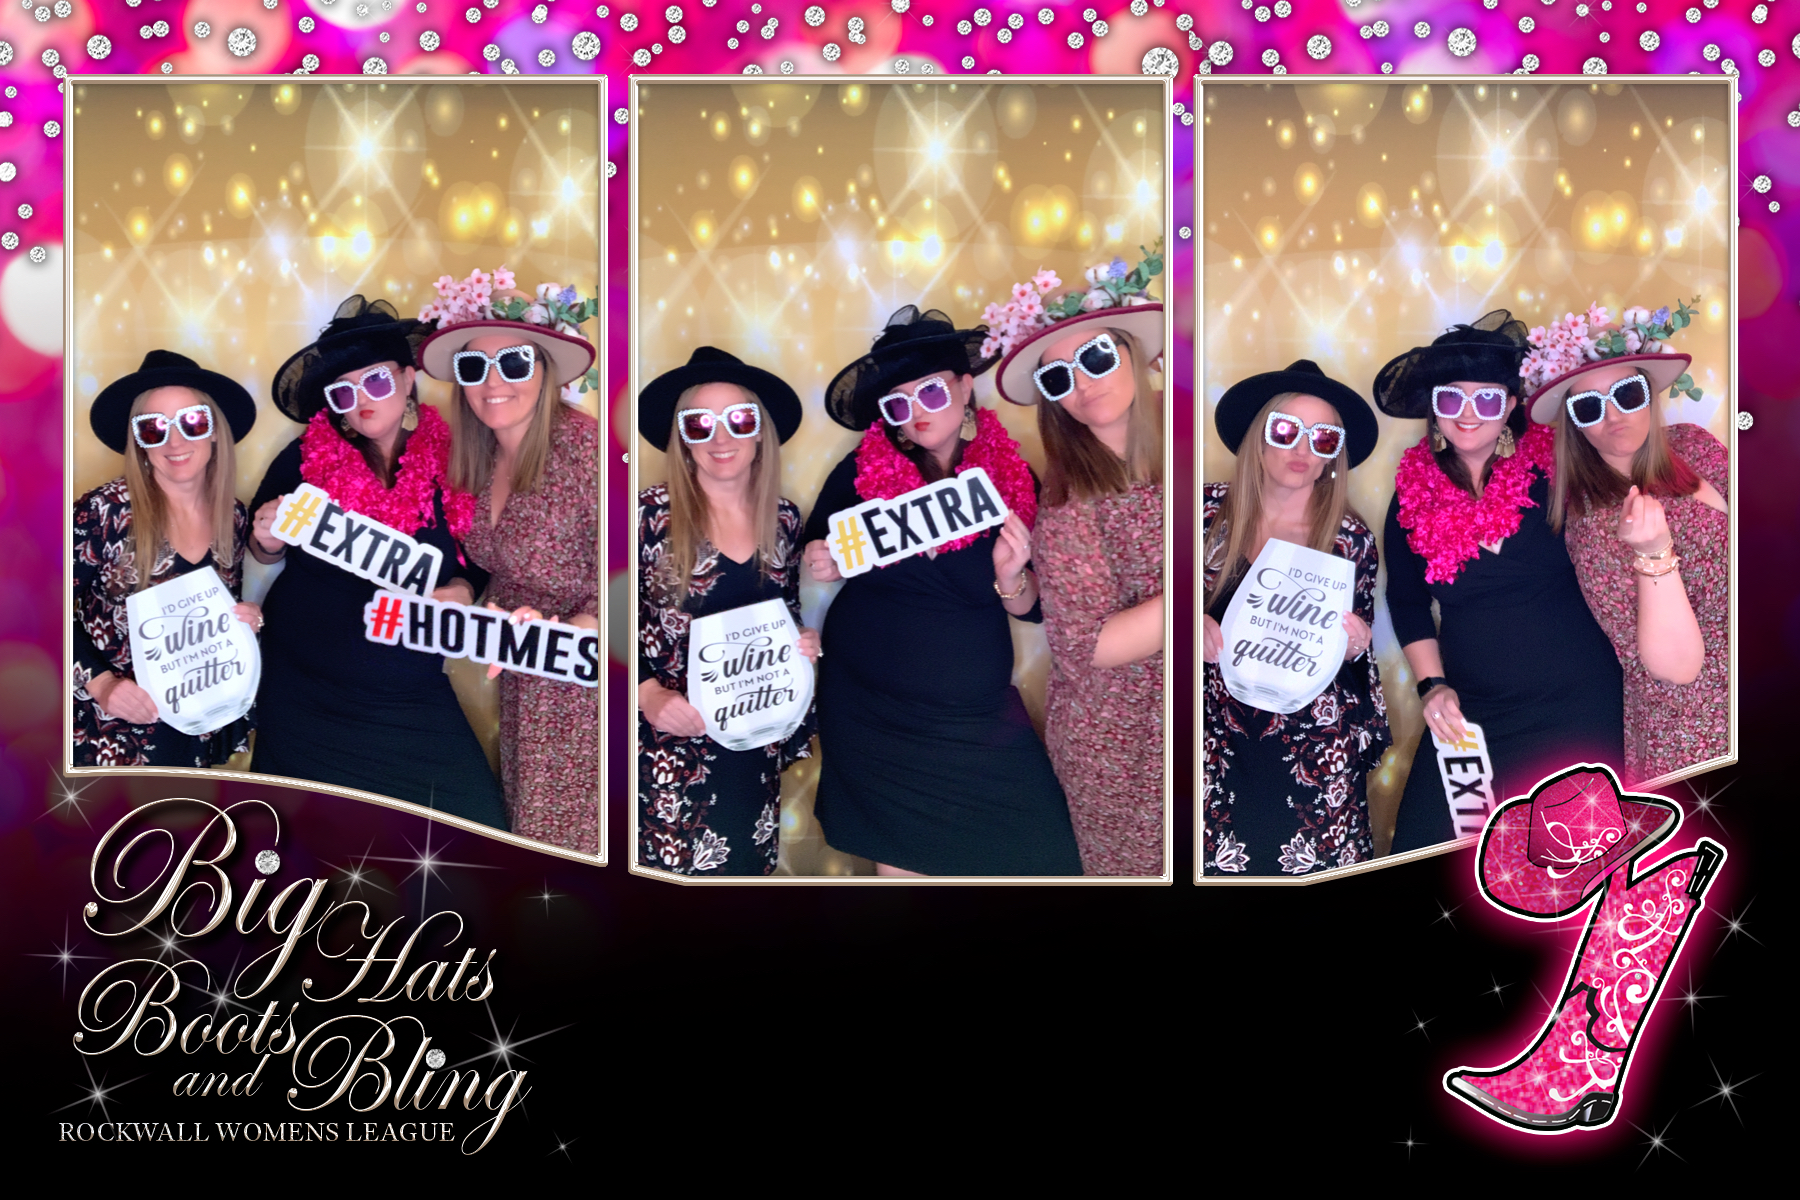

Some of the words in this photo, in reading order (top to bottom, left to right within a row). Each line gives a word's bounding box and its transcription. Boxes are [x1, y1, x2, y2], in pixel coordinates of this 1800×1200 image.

[835, 476, 1000, 570] #EXTRA
[278, 491, 434, 596] #EXTRA
[1288, 567, 1302, 579] I'D
[1304, 572, 1330, 588] GIVE
[1332, 580, 1347, 591] UP
[161, 604, 176, 615] I'D
[177, 592, 204, 609] GIVE
[204, 586, 219, 598] UP
[370, 596, 598, 682] #HOTMES
[725, 632, 740, 641] I'D
[742, 623, 769, 637] GIVE
[771, 619, 786, 630] UP
[1249, 615, 1273, 629] BUT
[1273, 622, 1289, 634] I'M
[1290, 626, 1315, 642] NOT
[1316, 636, 1323, 645] A
[160, 658, 181, 674] BUT
[183, 652, 199, 664] I'M
[200, 642, 223, 657] NOT
[226, 639, 234, 648] A
[1232, 637, 1323, 677] quitter
[165, 648, 246, 714] quitter
[714, 682, 736, 695] BUT
[739, 678, 754, 688] I'M
[756, 668, 780, 684] NOT
[782, 668, 790, 676] A
[714, 677, 799, 731] quitter
